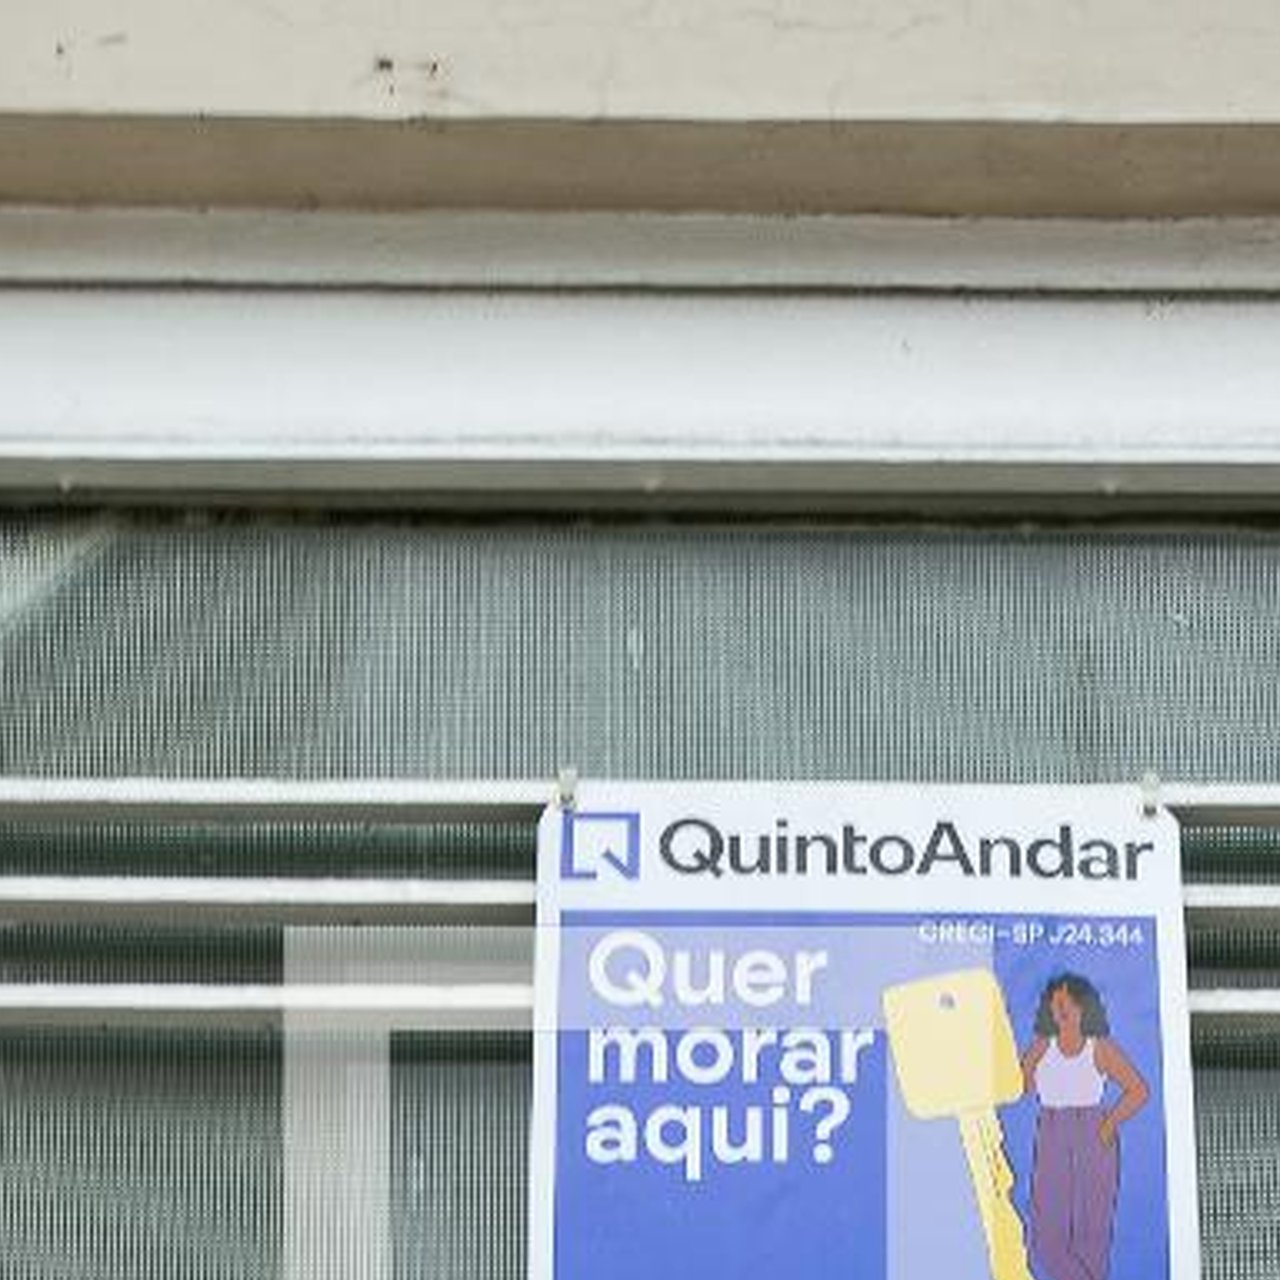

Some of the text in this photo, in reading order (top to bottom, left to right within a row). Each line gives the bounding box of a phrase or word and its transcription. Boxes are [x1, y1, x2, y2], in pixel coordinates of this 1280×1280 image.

[658, 817, 1154, 881] QuintoAndar
[918, 919, 1044, 946] CRECI-SP
[587, 929, 828, 1010] Quer
[587, 1024, 874, 1085] morar
[585, 1085, 851, 1181] aqui?
